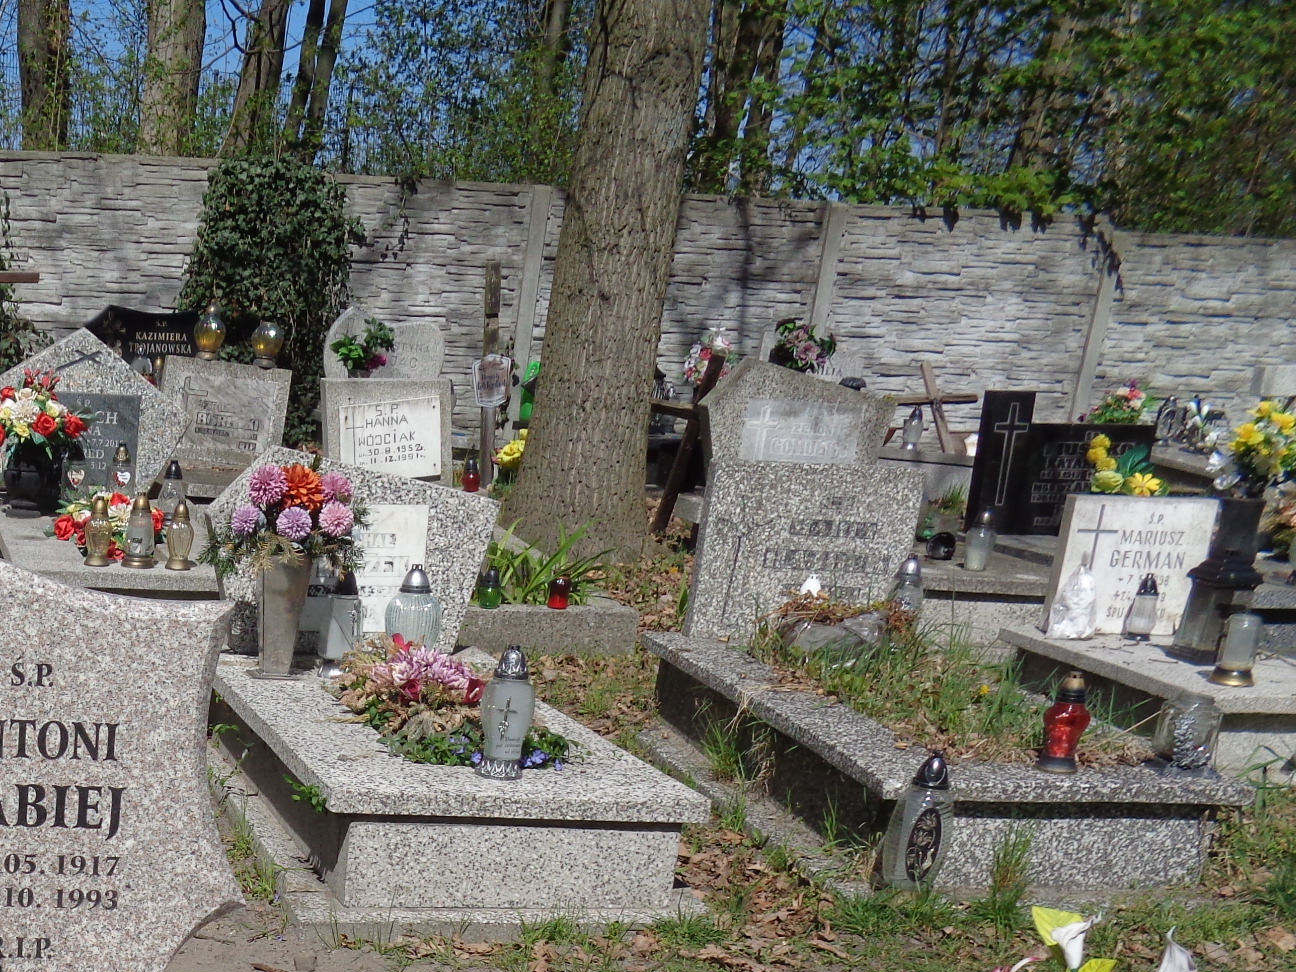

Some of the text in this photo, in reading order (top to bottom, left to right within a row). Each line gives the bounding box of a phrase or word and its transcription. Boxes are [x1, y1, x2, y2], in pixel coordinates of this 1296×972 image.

[135, 331, 187, 342] KAZIMIERA
[365, 414, 409, 429] HANNA
[1119, 529, 1186, 546] MARIUSZ
[1109, 549, 1187, 570] GERMAN
[10, 656, 54, 688] Ś.P.
[4, 853, 45, 875] 05.
[57, 855, 121, 877] 1917
[4, 887, 42, 908] 10.
[54, 887, 119, 911] 1993
